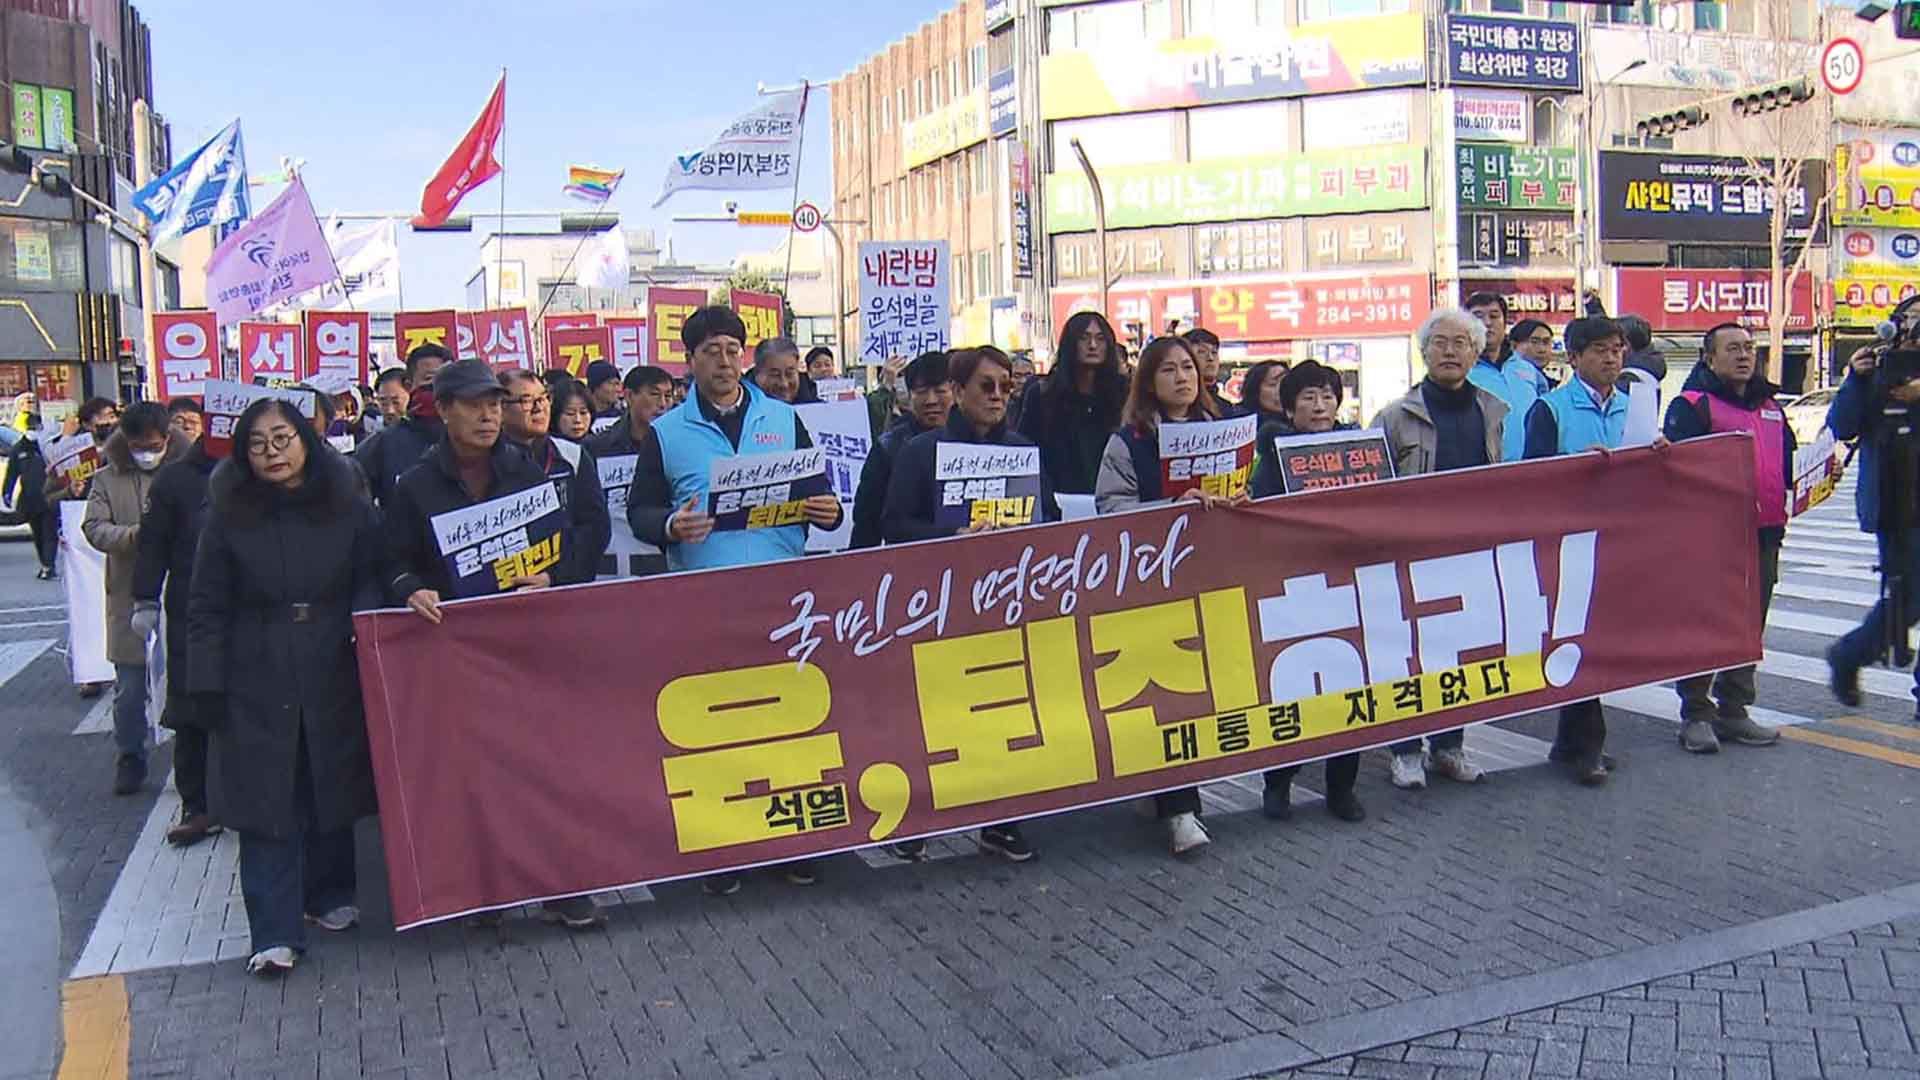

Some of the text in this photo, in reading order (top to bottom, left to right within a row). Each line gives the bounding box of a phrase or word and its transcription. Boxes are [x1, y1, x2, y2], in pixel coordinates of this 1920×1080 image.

[1450, 23, 1575, 53] 국민대출신 원장
[1459, 50, 1569, 79] 최상위반 직강
[1831, 51, 1855, 81] 50
[1319, 162, 1412, 197] 피부과
[1484, 153, 1576, 180] 비뇨기과
[1484, 179, 1576, 206] 피부과
[1624, 180, 1714, 213] 샤인뮤직
[799, 211, 816, 226] 40
[1316, 223, 1408, 264] 피부과
[864, 247, 938, 288] 내란범
[866, 293, 940, 329] 윤석열을
[1503, 292, 1550, 312] ENUS
[162, 321, 212, 396] 윤
[483, 319, 529, 369] 석
[1168, 450, 1238, 481] 윤석열
[1346, 447, 1383, 469] 정부
[715, 481, 792, 516] 윤석열
[942, 477, 1007, 506] 윤석열
[969, 495, 1036, 529] 퇴진!
[455, 526, 530, 578] 윤석열
[493, 530, 562, 591] 퇴진!
[768, 513, 1197, 672] 국민의 명령이다
[1161, 659, 1513, 765] 대통령 자격없다
[764, 783, 846, 834] 석열
